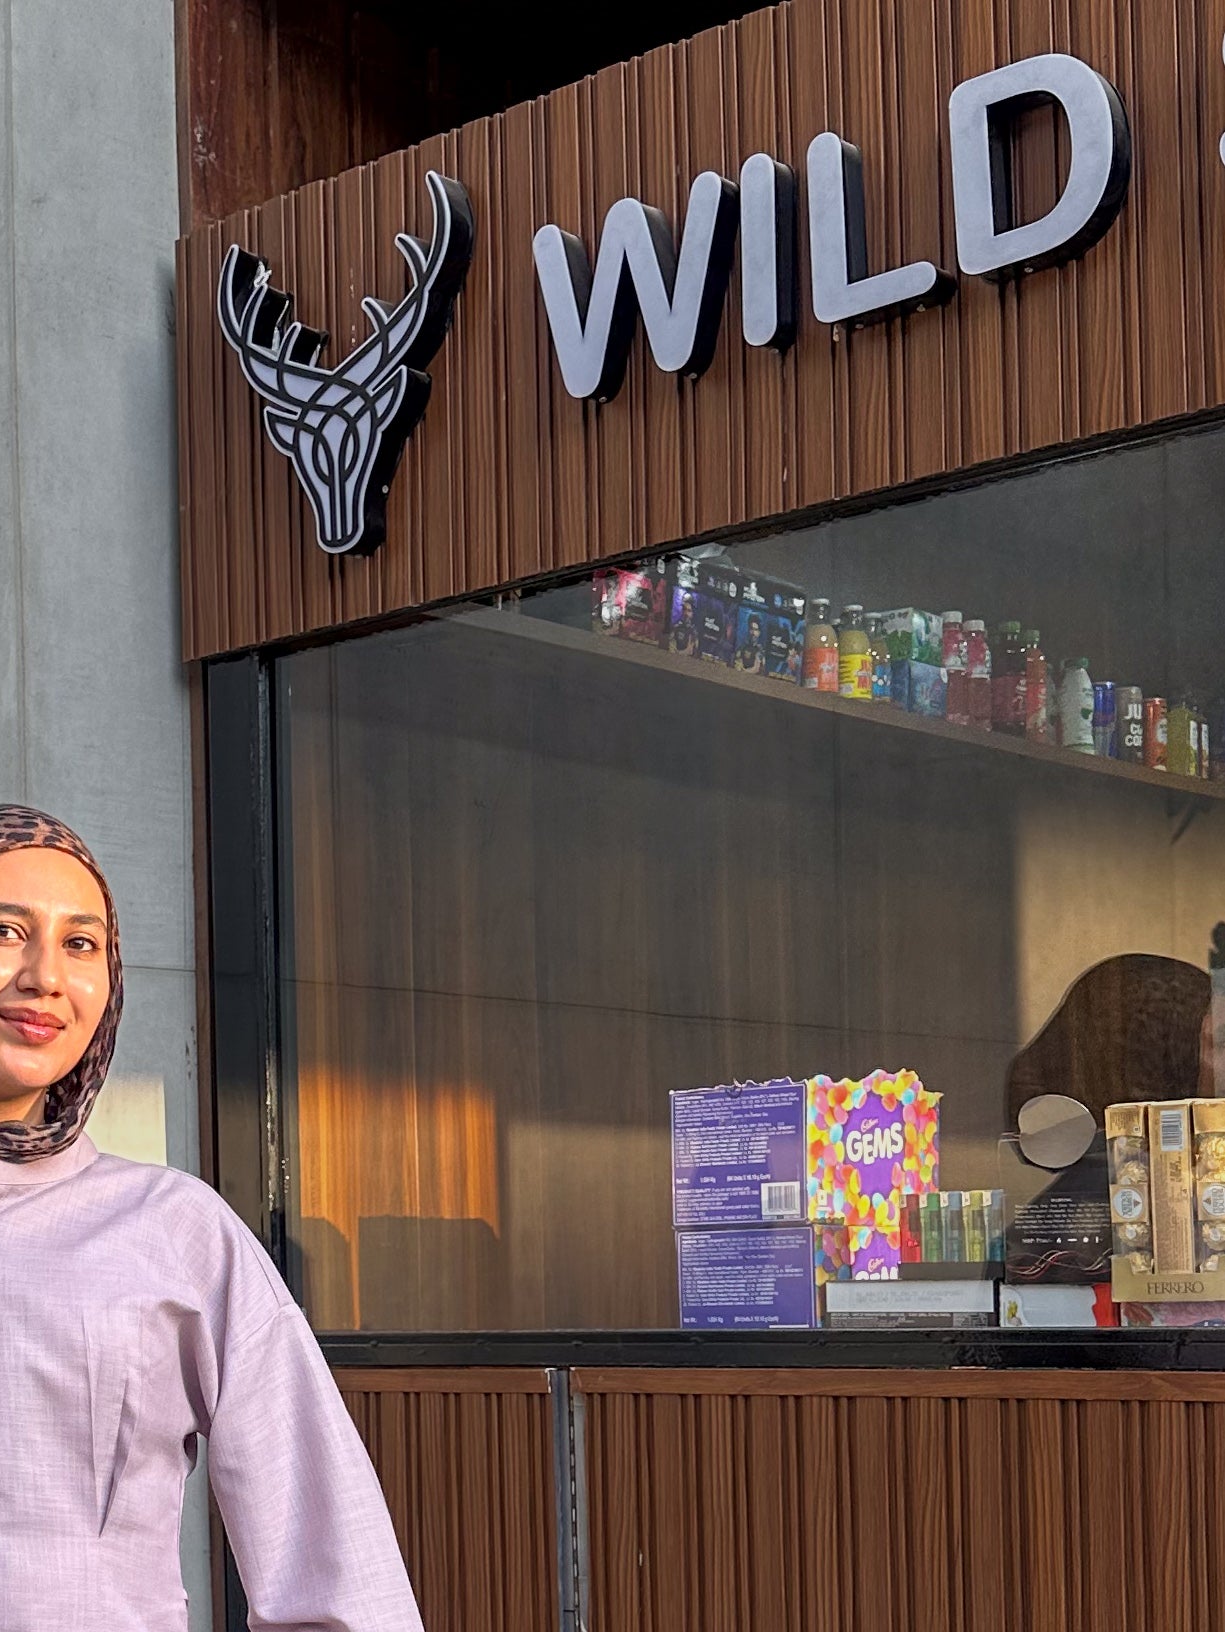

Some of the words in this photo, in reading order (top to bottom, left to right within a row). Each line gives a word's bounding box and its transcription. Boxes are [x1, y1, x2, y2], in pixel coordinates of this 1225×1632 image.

[533, 53, 1121, 399] WILD
[846, 1122, 904, 1165] GEMS
[1147, 1280, 1205, 1295] FERRERO
